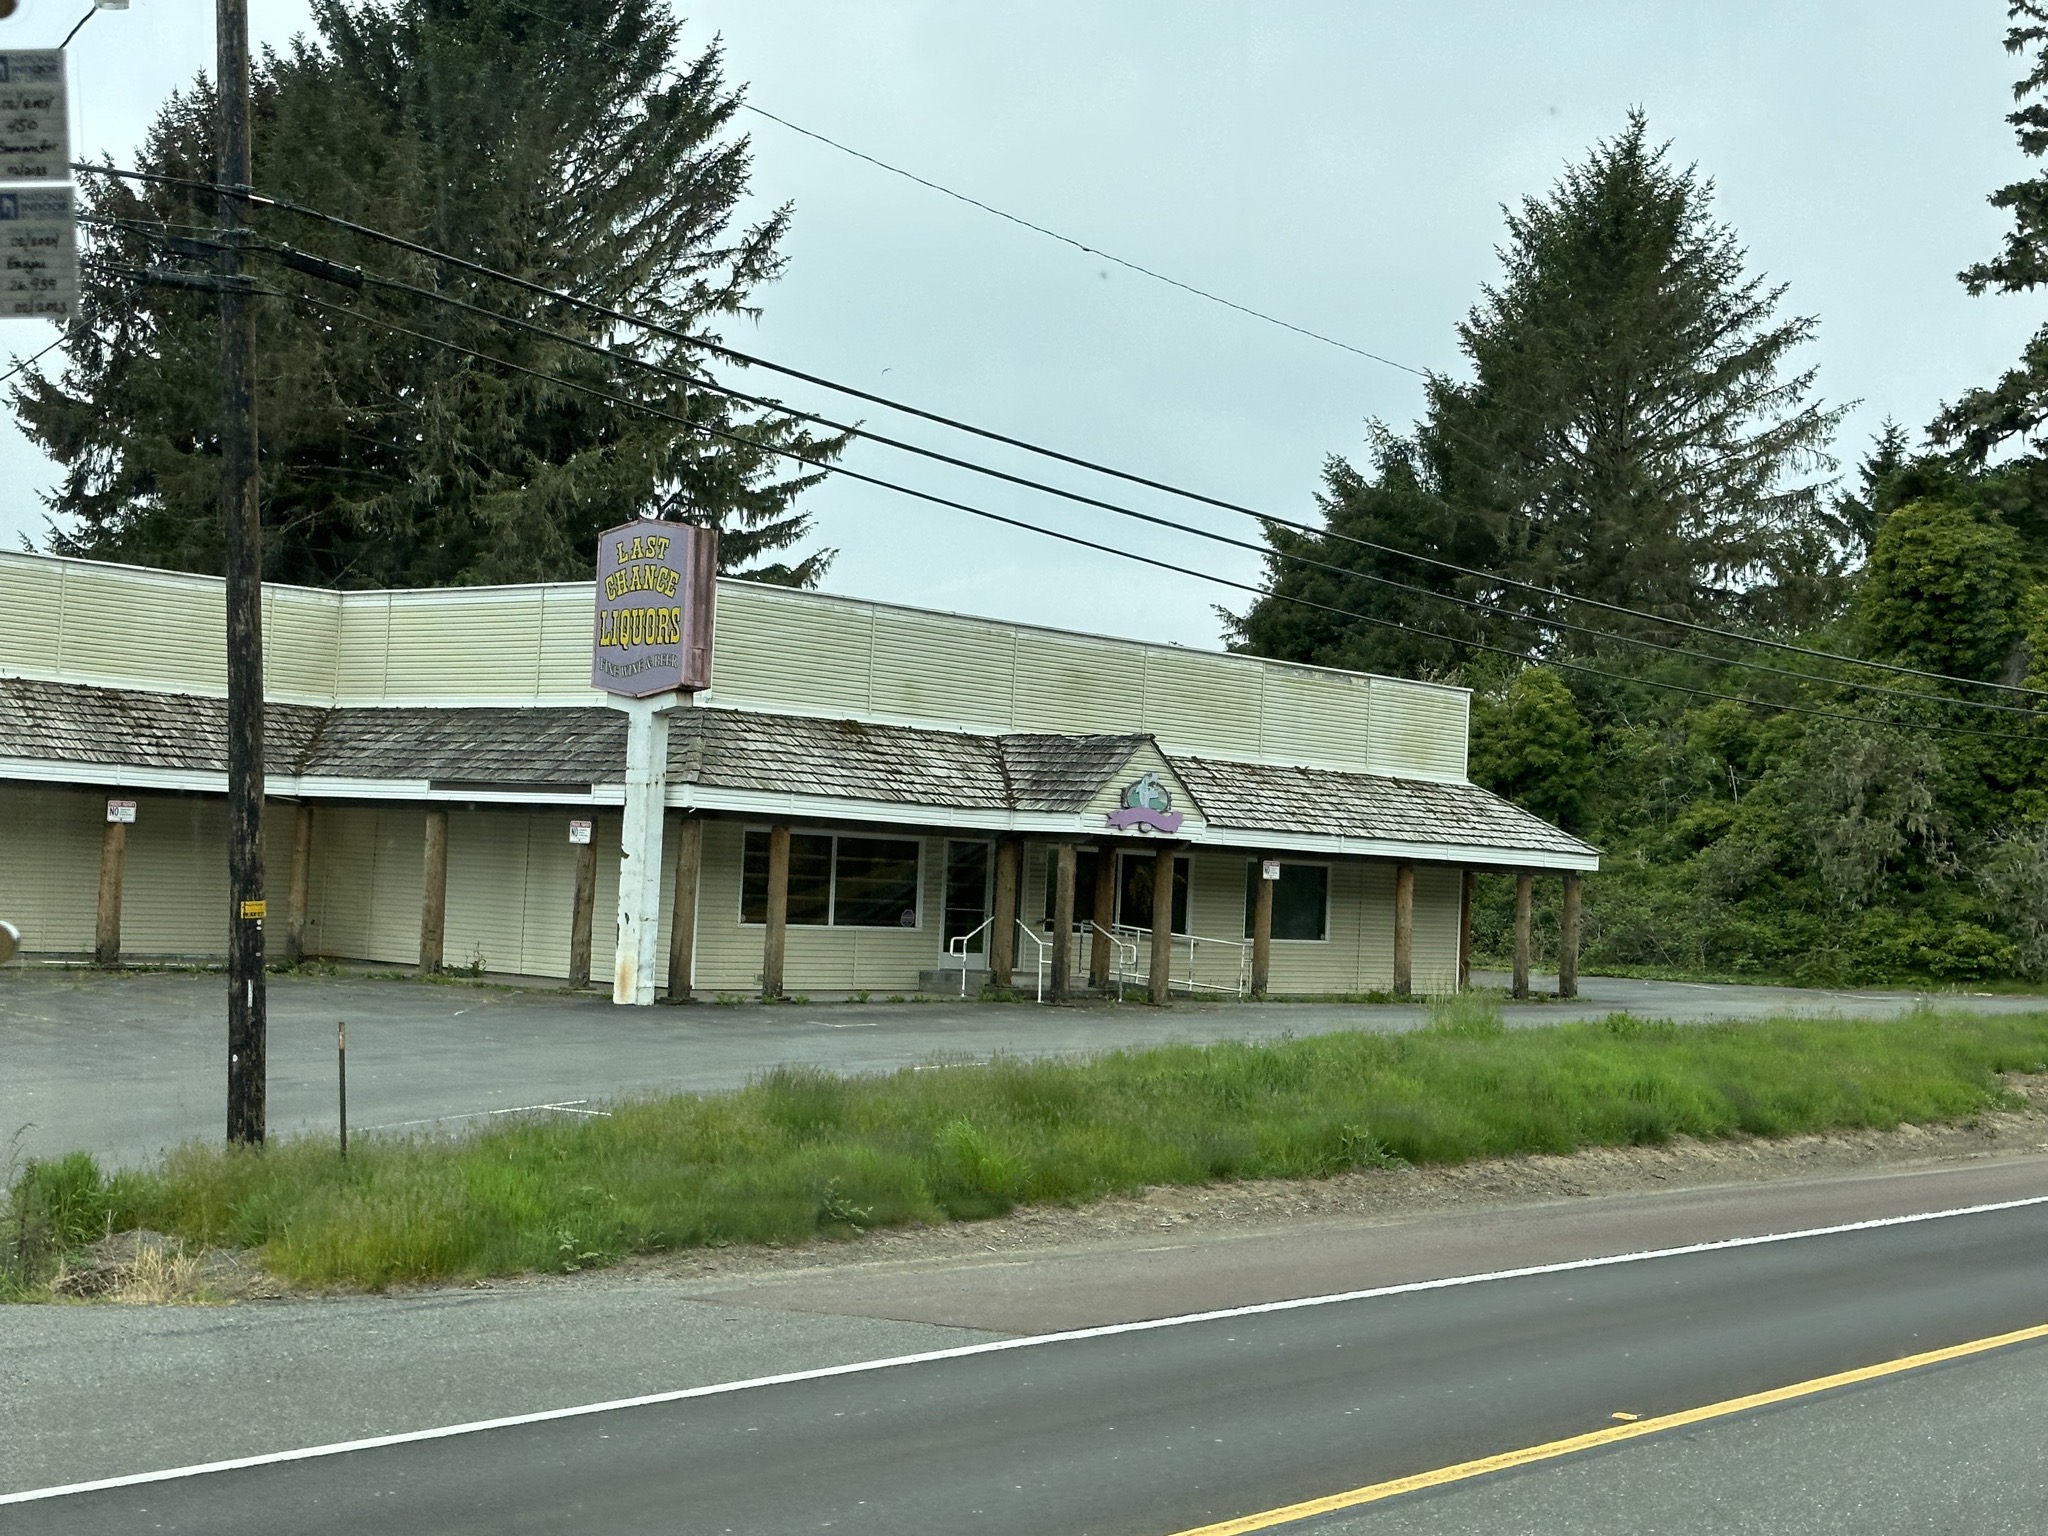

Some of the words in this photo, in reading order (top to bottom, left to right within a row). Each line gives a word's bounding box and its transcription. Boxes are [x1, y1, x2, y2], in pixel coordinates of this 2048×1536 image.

[616, 535, 670, 564] LAST
[605, 564, 680, 601] CHANCE
[600, 607, 681, 650] LIQUORS
[599, 656, 620, 678] FINE
[620, 659, 644, 678] WINE
[645, 656, 653, 670] &
[654, 653, 678, 669] BEER
[110, 807, 119, 816] NO
